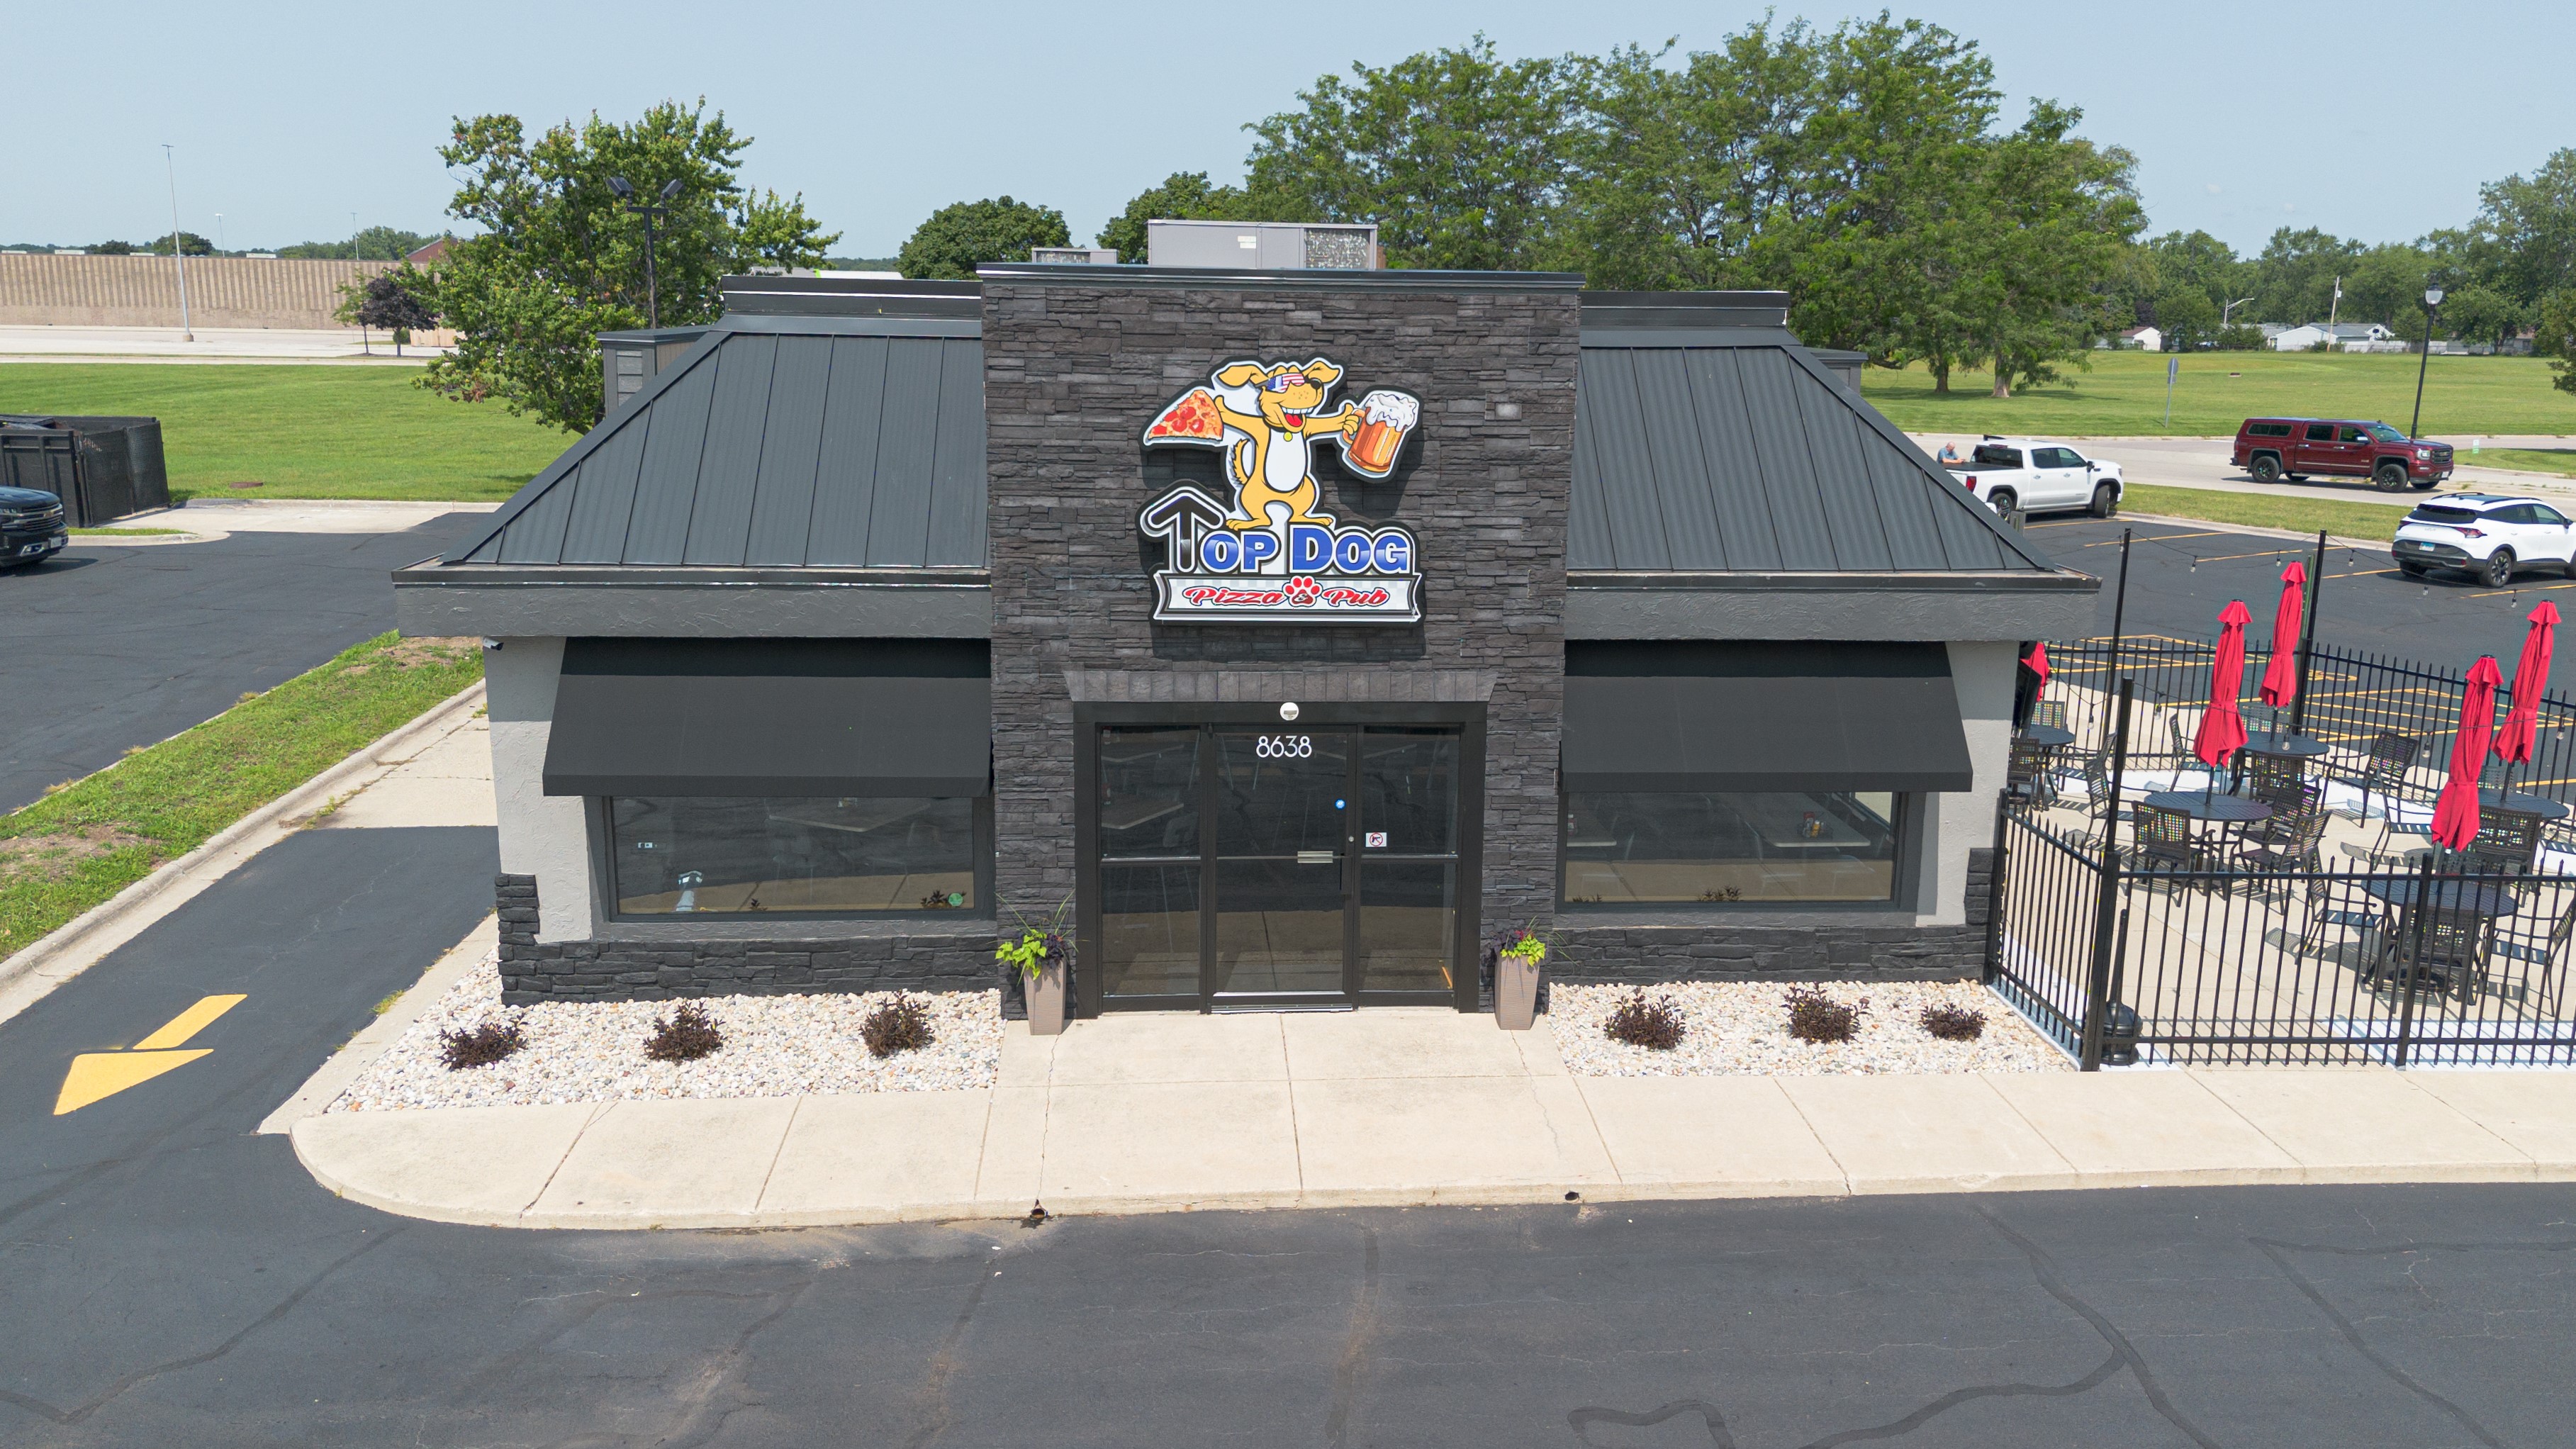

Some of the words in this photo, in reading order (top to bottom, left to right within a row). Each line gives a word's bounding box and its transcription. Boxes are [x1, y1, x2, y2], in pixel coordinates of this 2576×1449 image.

[1292, 527, 1408, 571] DOG
[1183, 586, 1286, 606] Pizza
[1322, 588, 1390, 606] Pub
[1256, 735, 1312, 758] 8638
